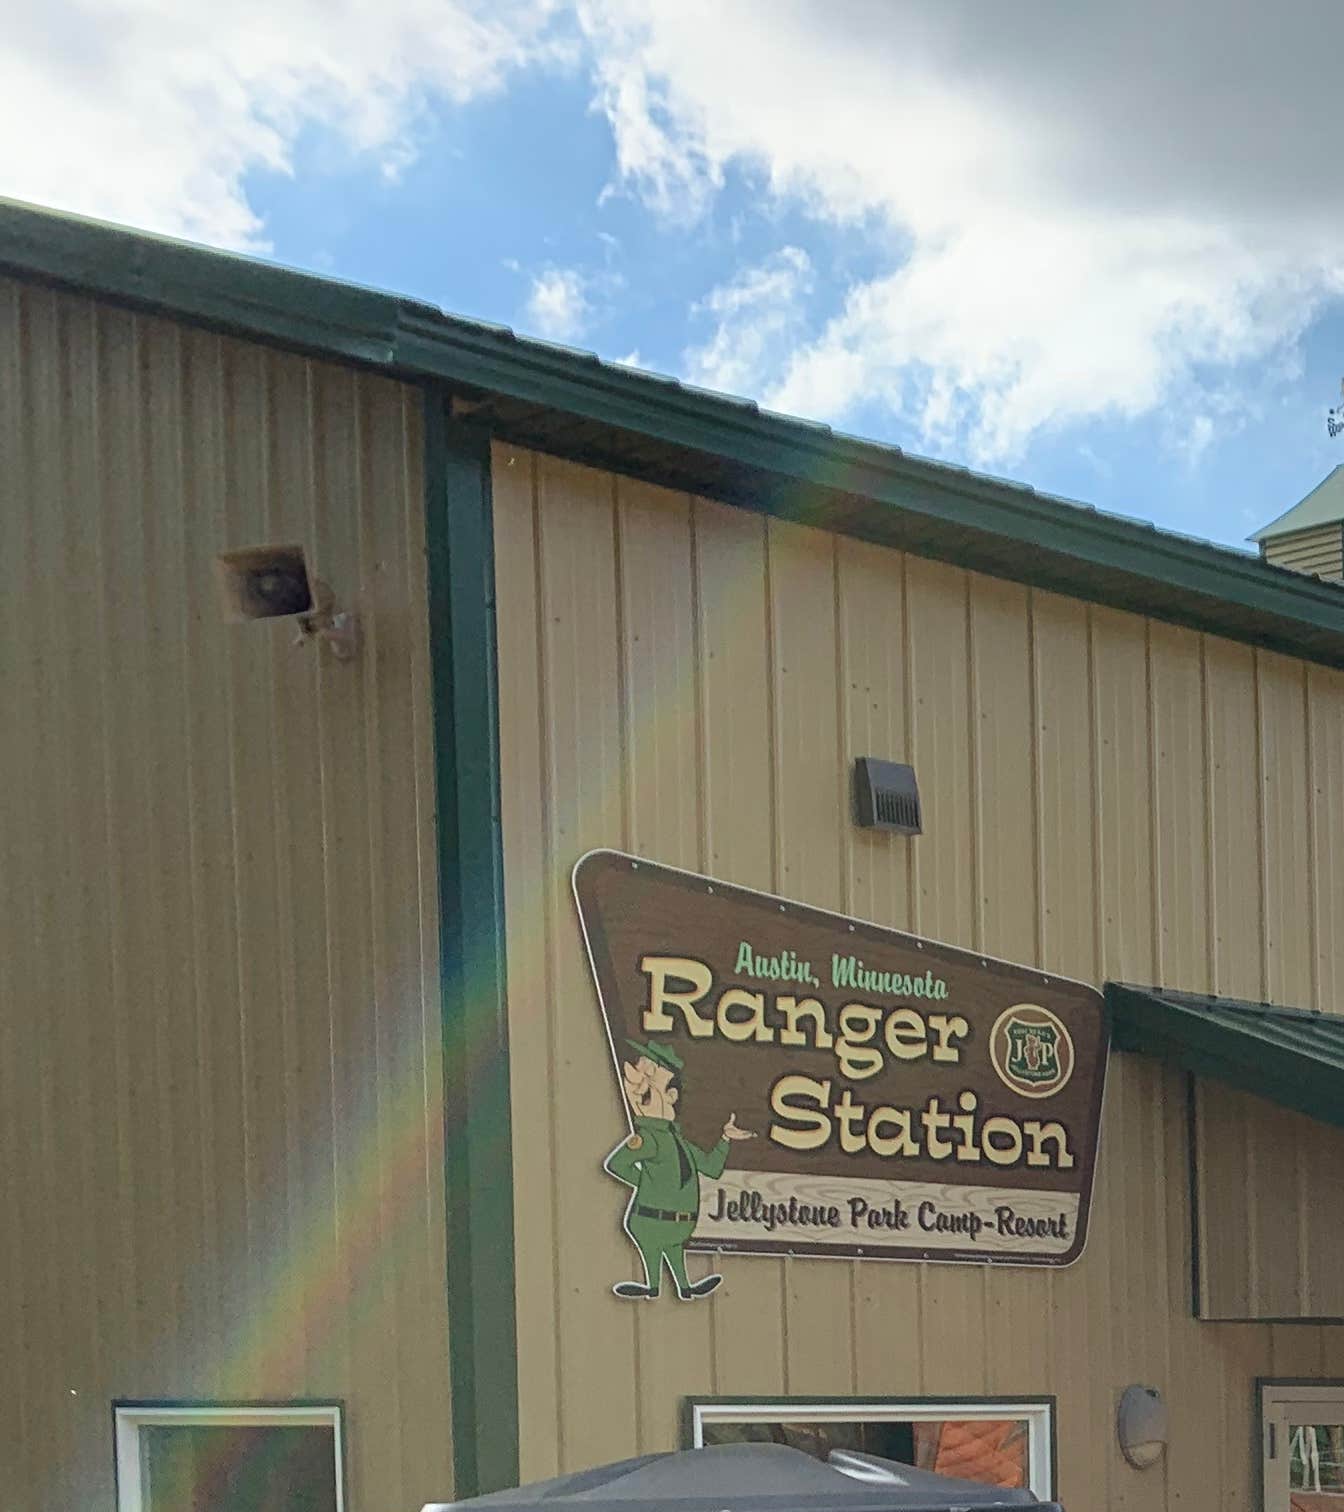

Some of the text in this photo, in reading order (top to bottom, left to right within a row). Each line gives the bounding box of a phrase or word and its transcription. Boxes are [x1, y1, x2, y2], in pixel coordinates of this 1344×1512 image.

[735, 941, 949, 1000] Austin, Minnesota
[640, 956, 969, 1080] Ranger
[770, 1075, 1074, 1168] Station
[708, 1188, 1071, 1242] Jellystone Park Camp-Resort
